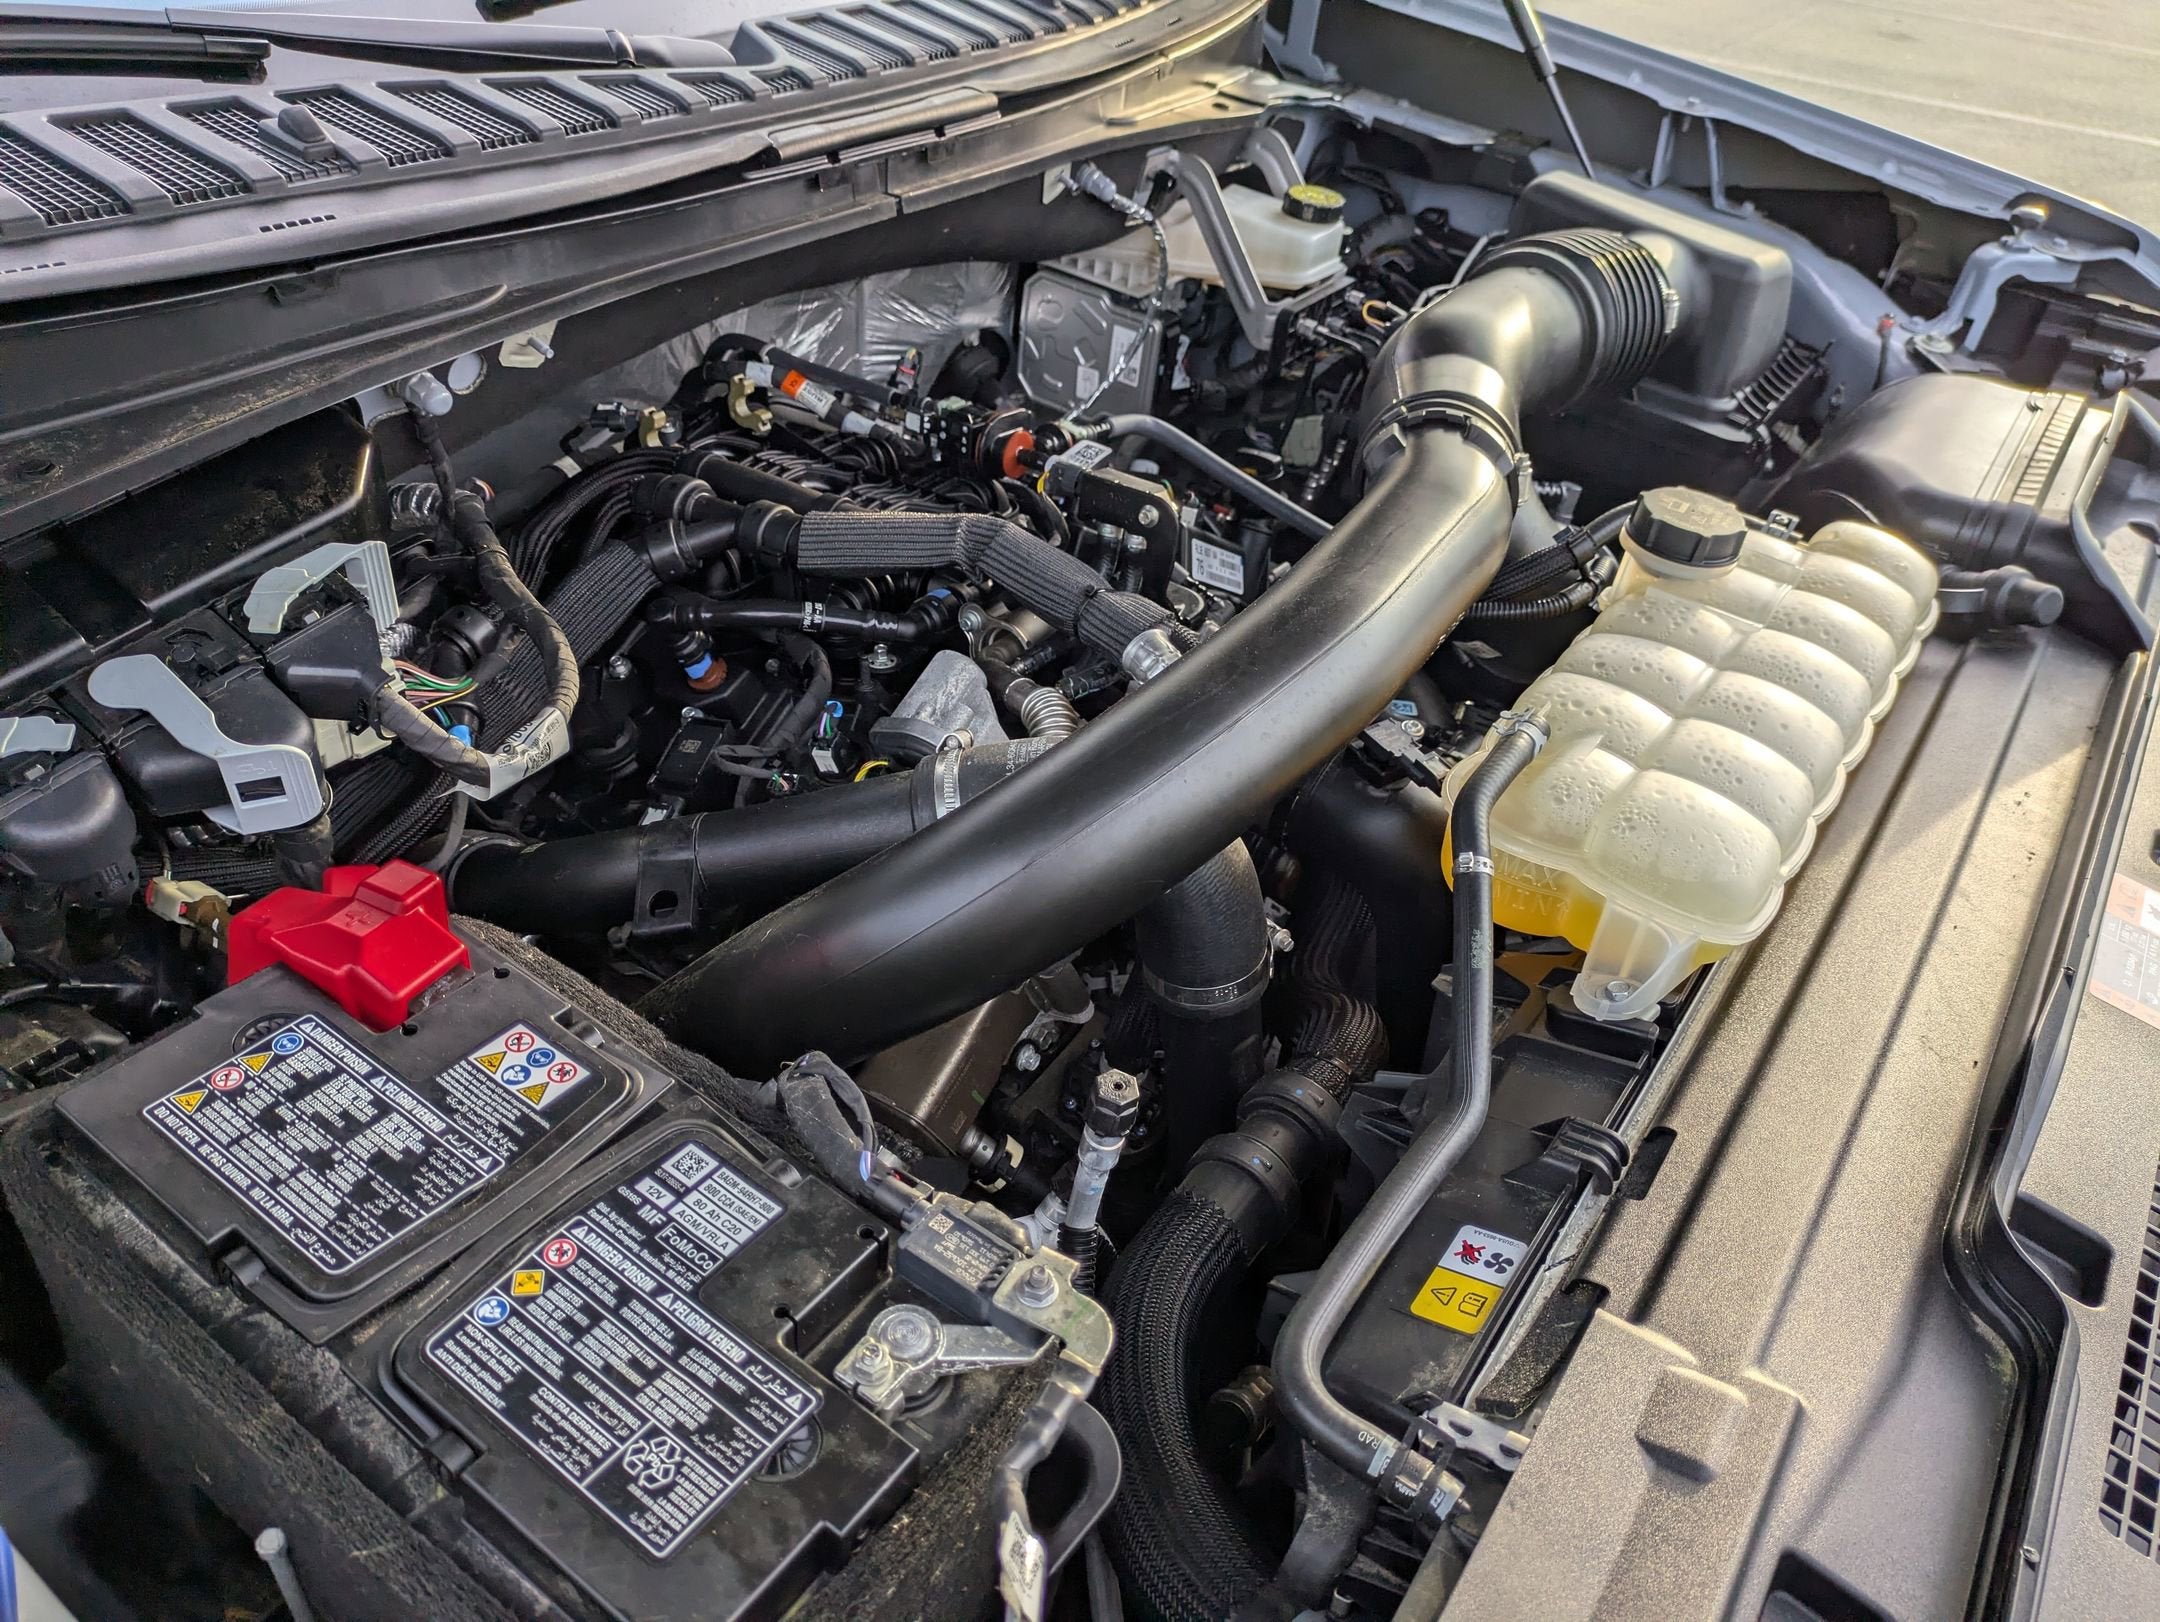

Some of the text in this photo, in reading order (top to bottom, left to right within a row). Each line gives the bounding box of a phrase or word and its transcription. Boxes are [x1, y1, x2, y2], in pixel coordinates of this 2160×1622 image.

[307, 1026, 373, 1075] DANGER/POISON
[378, 1081, 448, 1133] PELIGRO/VENENO
[152, 1105, 171, 1119] DO
[162, 1113, 184, 1130] NOT
[175, 1125, 205, 1147] OPEN.
[196, 1143, 215, 1157] NE
[205, 1150, 228, 1168] PAS
[218, 1162, 255, 1190] OUVRIR.
[643, 1183, 667, 1202] 12V
[246, 1186, 298, 1228] NO LA ABRA.
[701, 1182, 722, 1198] 800
[715, 1192, 737, 1209] CCA
[585, 1207, 604, 1222] Ford
[598, 1216, 619, 1234] Motor
[635, 1203, 668, 1229] MF
[673, 1207, 731, 1251] AGM/VRLA
[690, 1197, 743, 1236] 80 Ah C20
[574, 1256, 592, 1272] KEEP
[581, 1231, 658, 1293] DANGER/POISON
[659, 1226, 718, 1271] FoMoCo
[565, 1263, 587, 1282] REACH
[496, 1322, 516, 1339] LIRE
[509, 1333, 526, 1348] LES
[505, 1315, 527, 1333] READ
[667, 1299, 748, 1364] PELIGRO/VENENO
[454, 1330, 515, 1385] Lead Acid Battery
[463, 1322, 523, 1375] NON-SPILLABLE
[433, 1346, 509, 1411] ANTI DÉVERSEMENT
[443, 1338, 475, 1366] Batterie
[476, 1368, 505, 1393] plomb
[571, 1370, 590, 1386] LEA
[582, 1379, 600, 1395] LAS
[535, 1384, 571, 1415] CONTRA
[566, 1410, 613, 1451] DERRAMES
[1358, 1431, 1381, 1450] RAD
[644, 1452, 663, 1469] Pb
